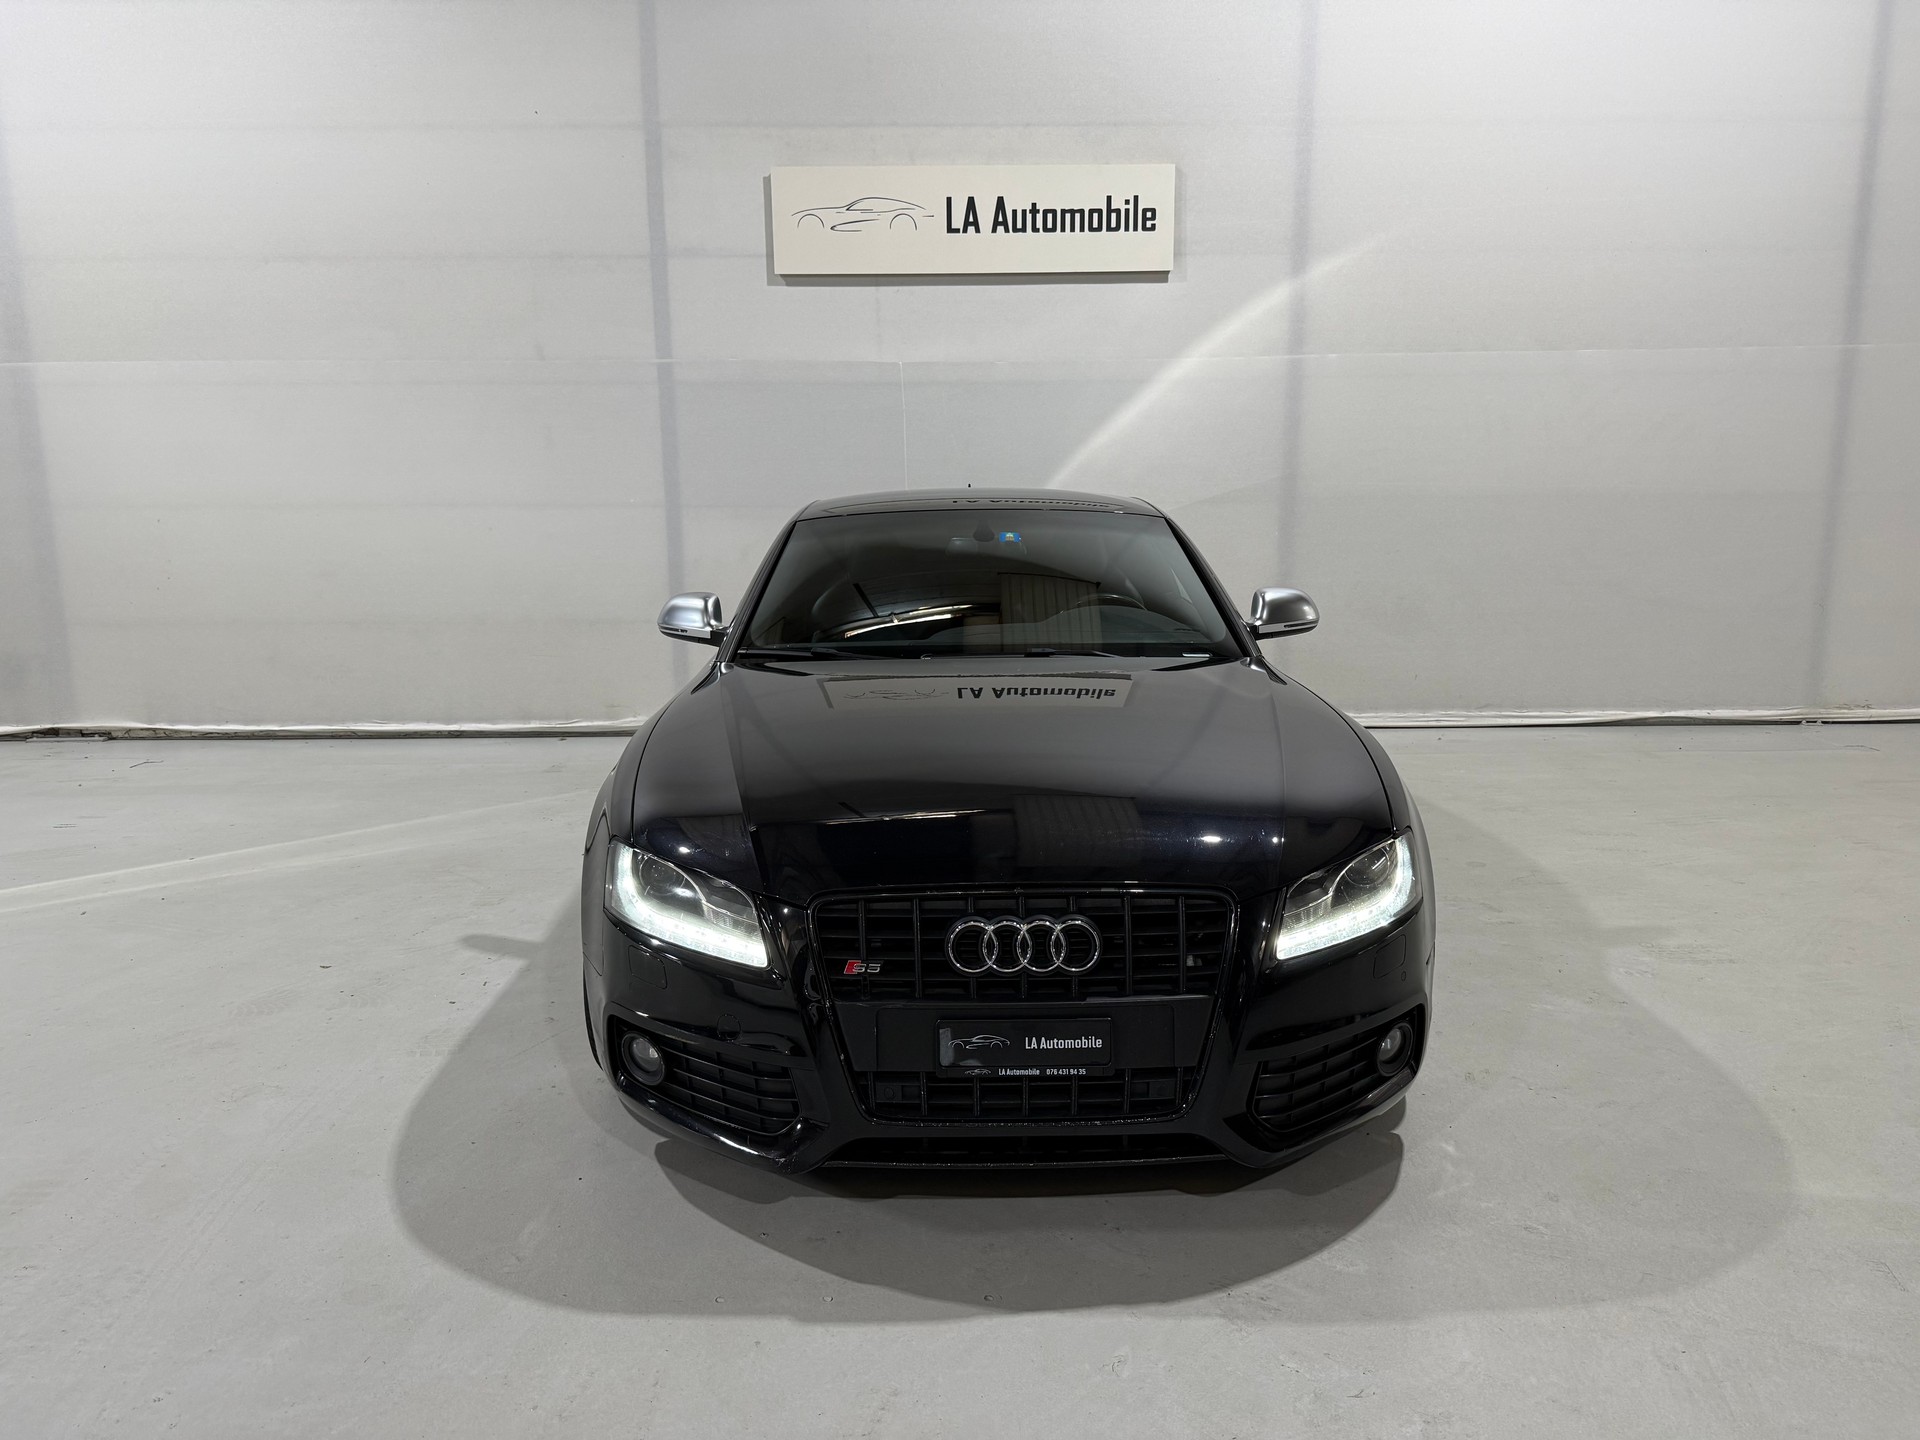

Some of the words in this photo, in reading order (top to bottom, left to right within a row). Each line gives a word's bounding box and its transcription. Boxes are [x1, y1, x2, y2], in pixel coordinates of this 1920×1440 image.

[945, 196, 981, 234] LA
[990, 194, 1157, 234] Automobile
[1025, 1037, 1038, 1049] LA
[1040, 1036, 1103, 1049] Automobile
[998, 1068, 1006, 1076] LA
[1006, 1068, 1040, 1076] Automobile
[1046, 1068, 1058, 1076] 076
[1058, 1068, 1069, 1076] 431
[1069, 1068, 1078, 1076] 94
[1078, 1068, 1087, 1076] 35
